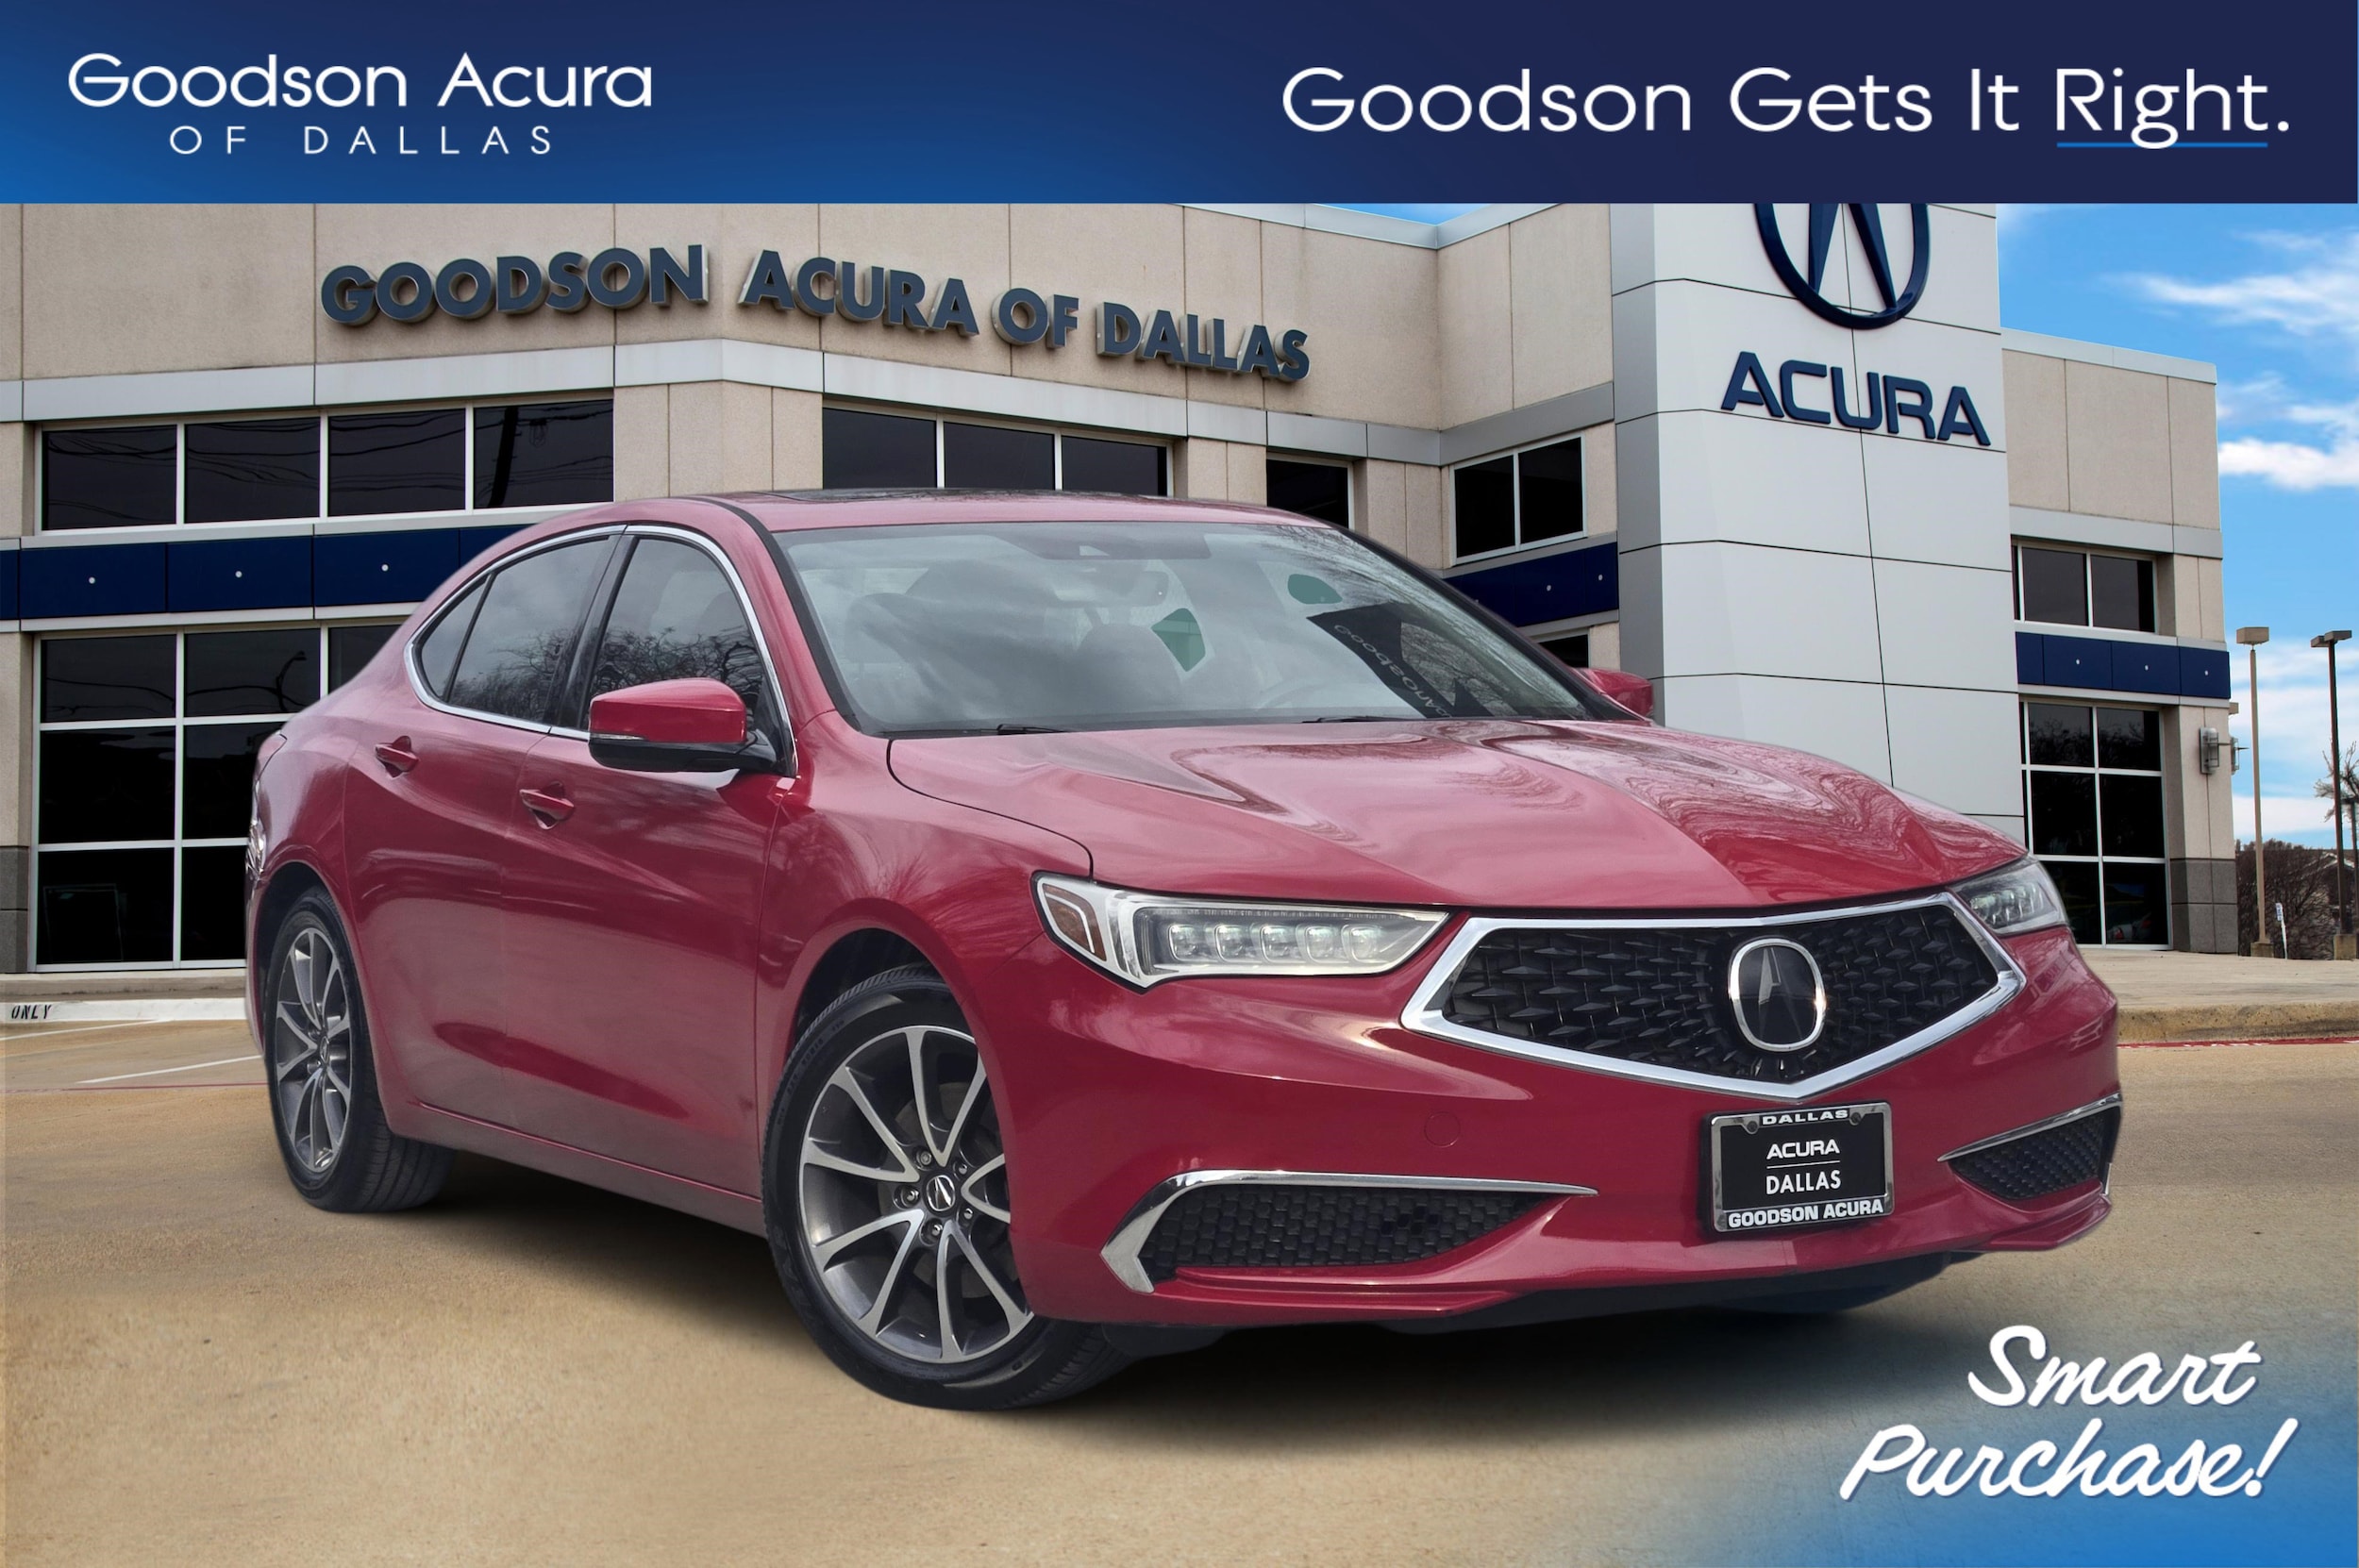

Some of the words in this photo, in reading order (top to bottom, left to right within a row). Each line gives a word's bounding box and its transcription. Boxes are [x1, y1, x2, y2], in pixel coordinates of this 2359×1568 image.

[322, 244, 709, 326] GOODSON
[738, 249, 979, 337] ACURA
[991, 288, 1079, 348] OF
[1095, 301, 1311, 382] DALLAS
[1720, 351, 1992, 447] ACURA
[11, 1005, 52, 1020] ONLY
[1762, 1109, 1849, 1126] DALLAS
[1765, 1138, 1840, 1160] ACURA
[1765, 1169, 1841, 1195] DALLAS
[1728, 1206, 1819, 1228] GOODSON
[1823, 1199, 1884, 1220] ACURA
